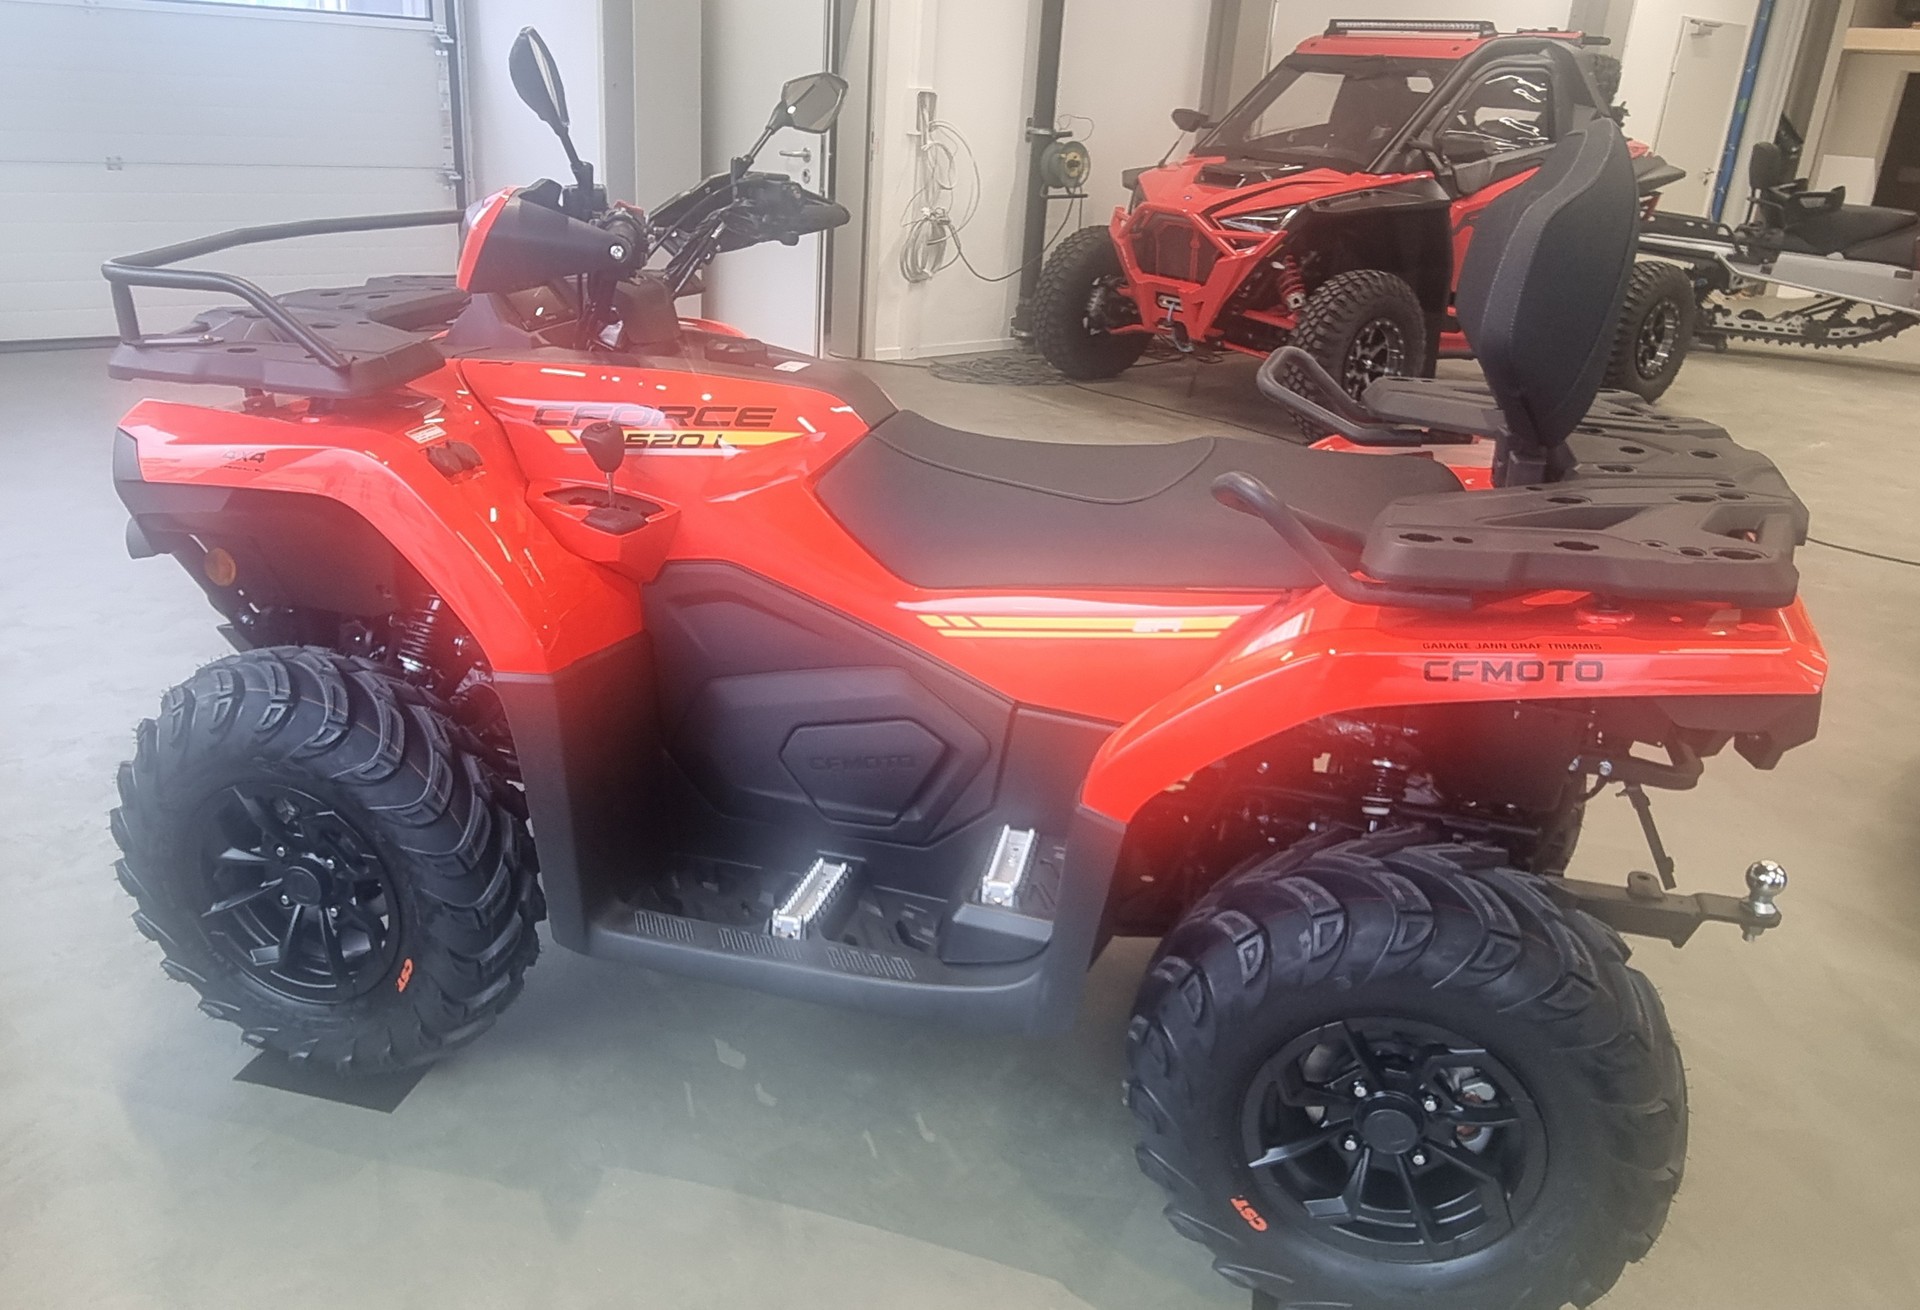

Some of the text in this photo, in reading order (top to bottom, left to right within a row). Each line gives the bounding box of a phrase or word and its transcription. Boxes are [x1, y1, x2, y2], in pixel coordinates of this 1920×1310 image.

[532, 405, 777, 428] CFORCE
[622, 433, 705, 449] 520
[1422, 642, 1602, 650] GARAGE JANN GRAF TRIMMIS
[1423, 660, 1604, 682] CFMOTO
[1230, 1198, 1268, 1232] CST
